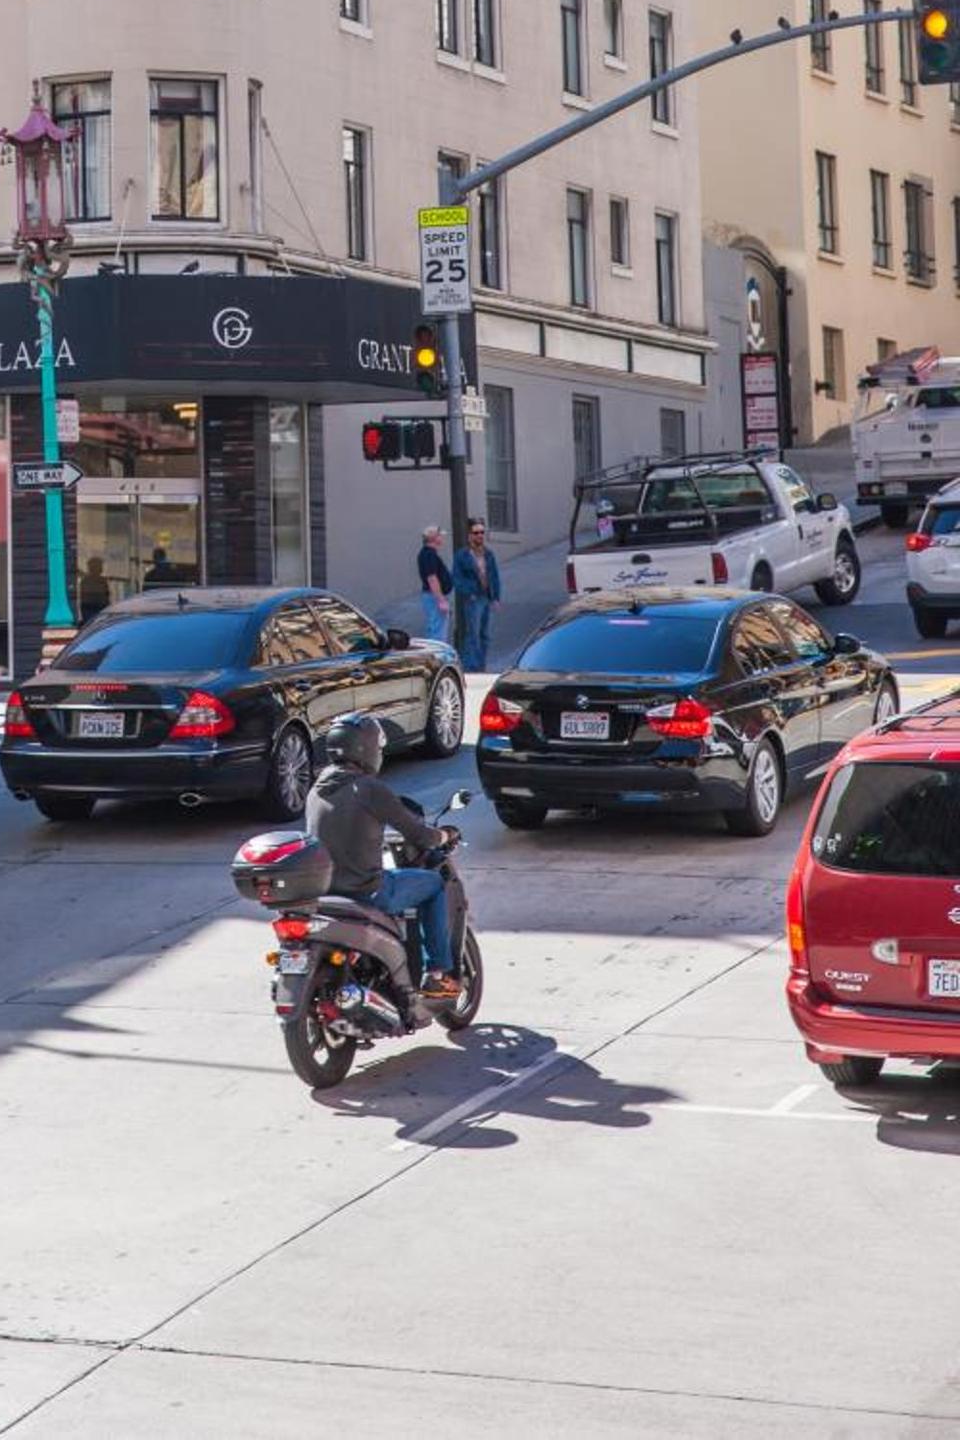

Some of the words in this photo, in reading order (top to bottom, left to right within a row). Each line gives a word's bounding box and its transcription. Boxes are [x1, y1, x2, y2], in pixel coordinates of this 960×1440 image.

[422, 211, 465, 223] SCHOOL
[424, 231, 466, 244] SPEED
[428, 245, 461, 257] LIMIT
[426, 259, 466, 283] 25
[358, 338, 412, 374] GRANT
[18, 470, 39, 484] ONE
[43, 469, 63, 481] WAY
